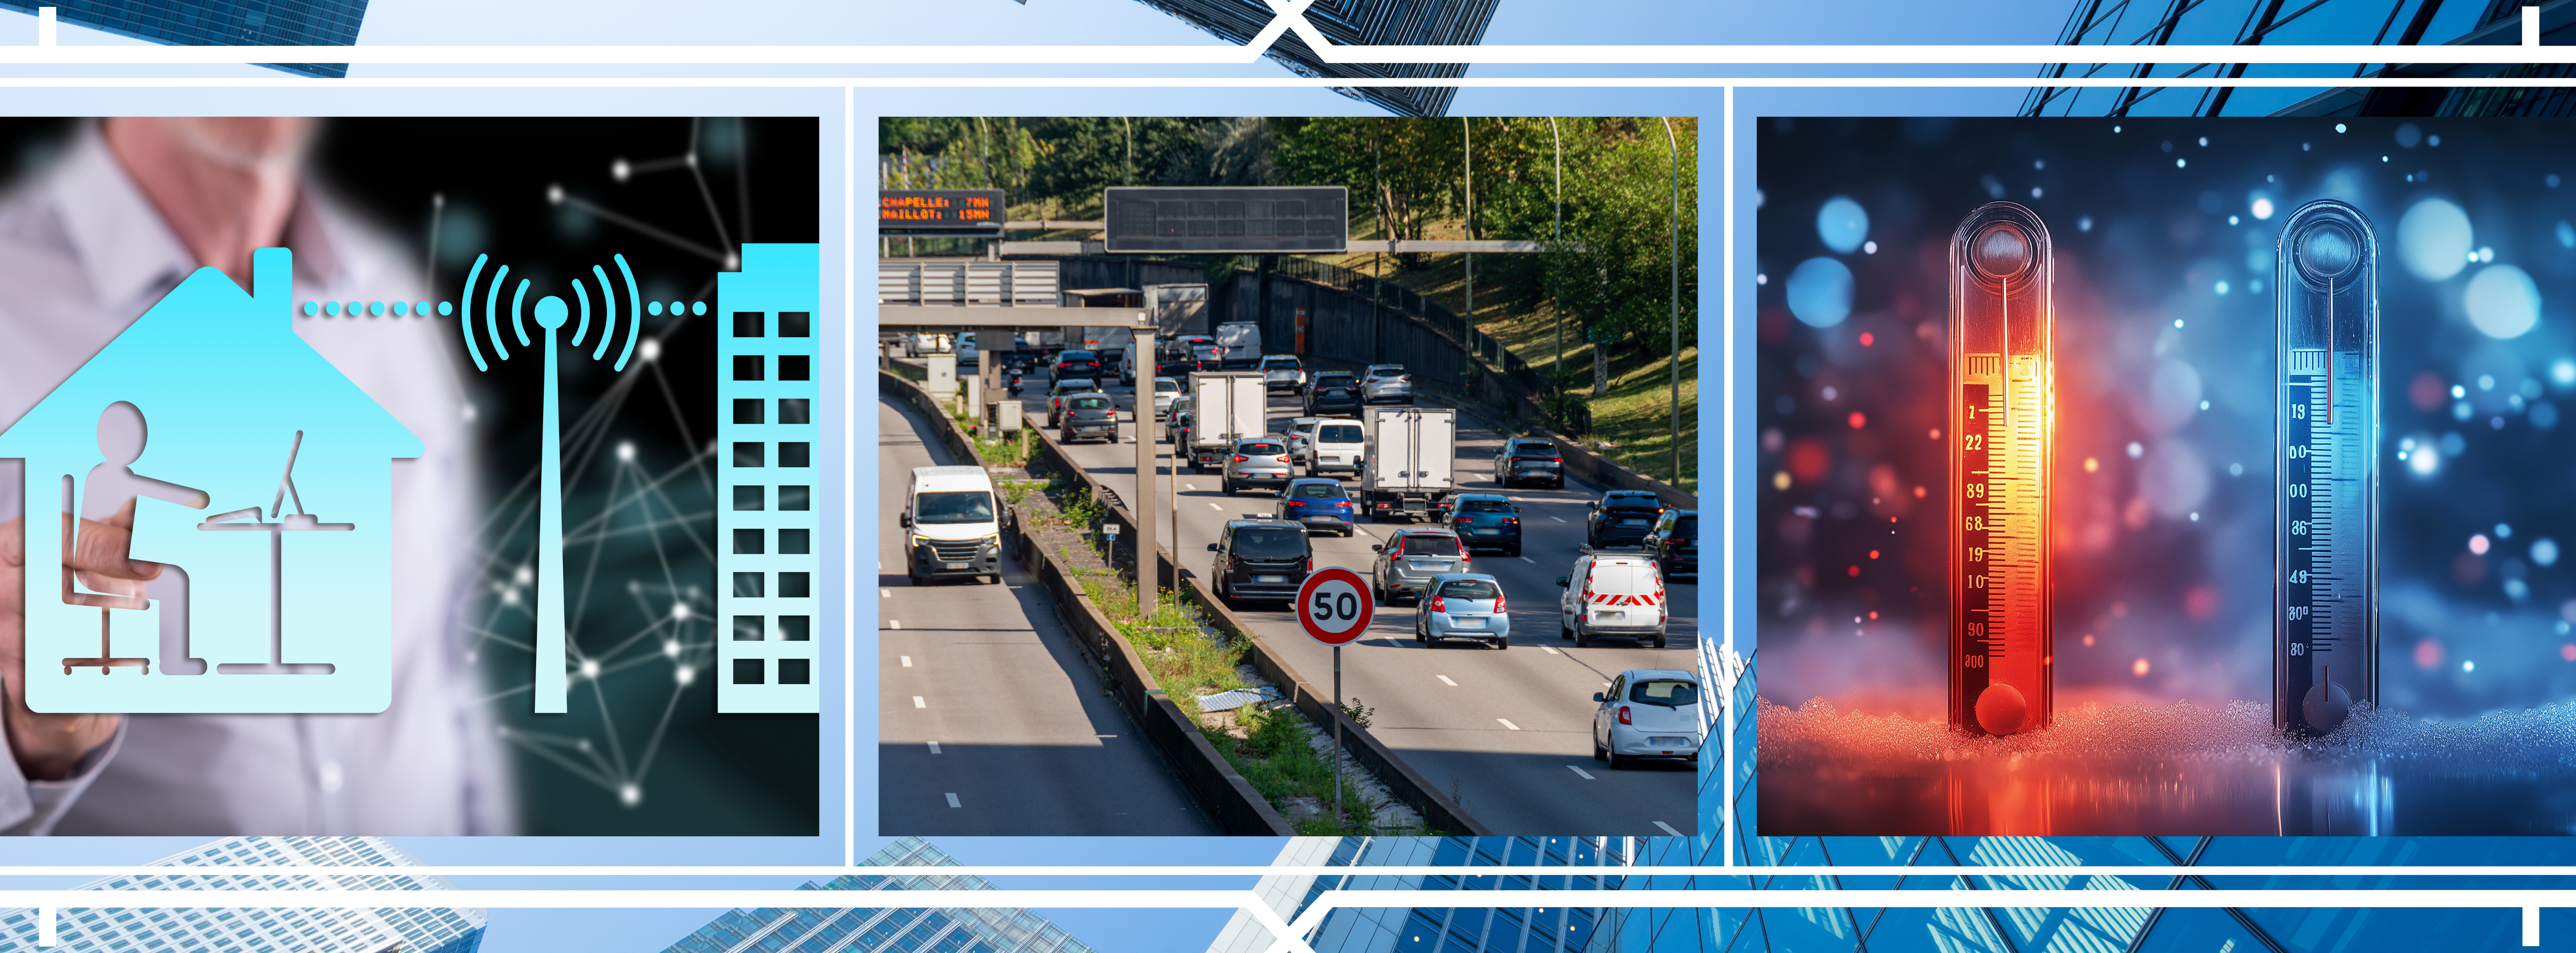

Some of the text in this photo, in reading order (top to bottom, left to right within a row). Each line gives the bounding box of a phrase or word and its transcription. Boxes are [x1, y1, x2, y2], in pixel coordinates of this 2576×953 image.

[1965, 435, 1982, 450] 22
[1966, 483, 1984, 499] 89
[2290, 484, 2307, 497] 00
[1966, 516, 1983, 531] 68
[1968, 547, 1983, 562] 19
[1968, 575, 1984, 588] 10
[1314, 592, 1357, 620] 50
[1968, 622, 1984, 636] 90
